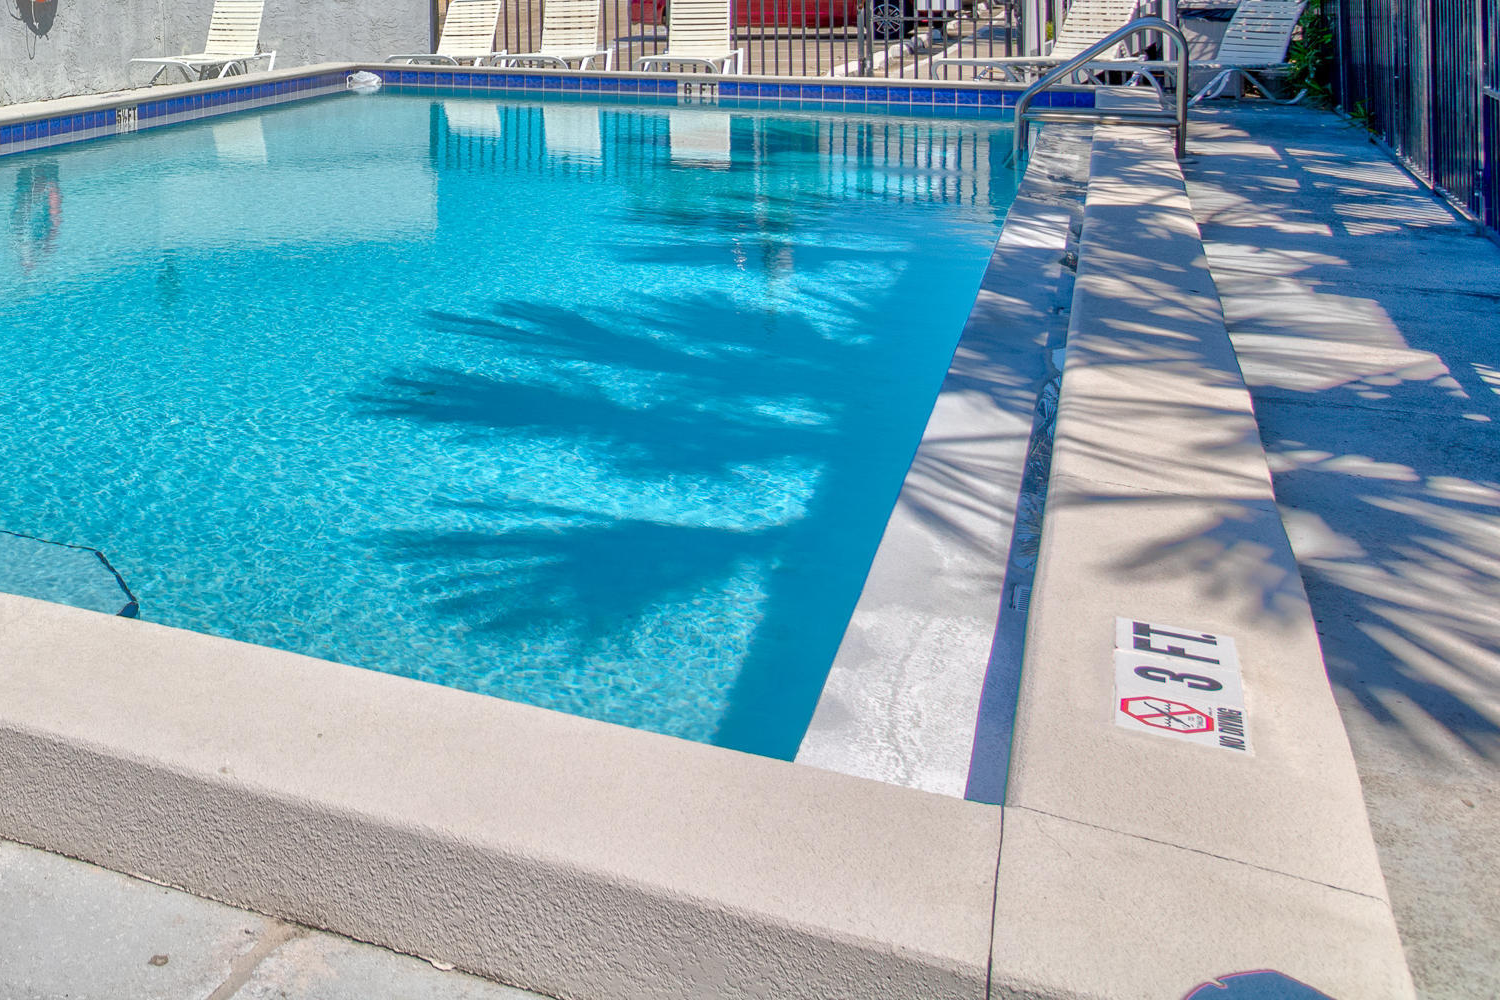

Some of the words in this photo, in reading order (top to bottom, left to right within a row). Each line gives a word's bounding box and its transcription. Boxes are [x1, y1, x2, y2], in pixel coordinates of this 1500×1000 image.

[684, 82, 692, 95] 6
[1132, 621, 1220, 665] FT.
[1134, 666, 1223, 692] 3
[1216, 707, 1244, 737] DIVING
[1219, 735, 1246, 751] NO
